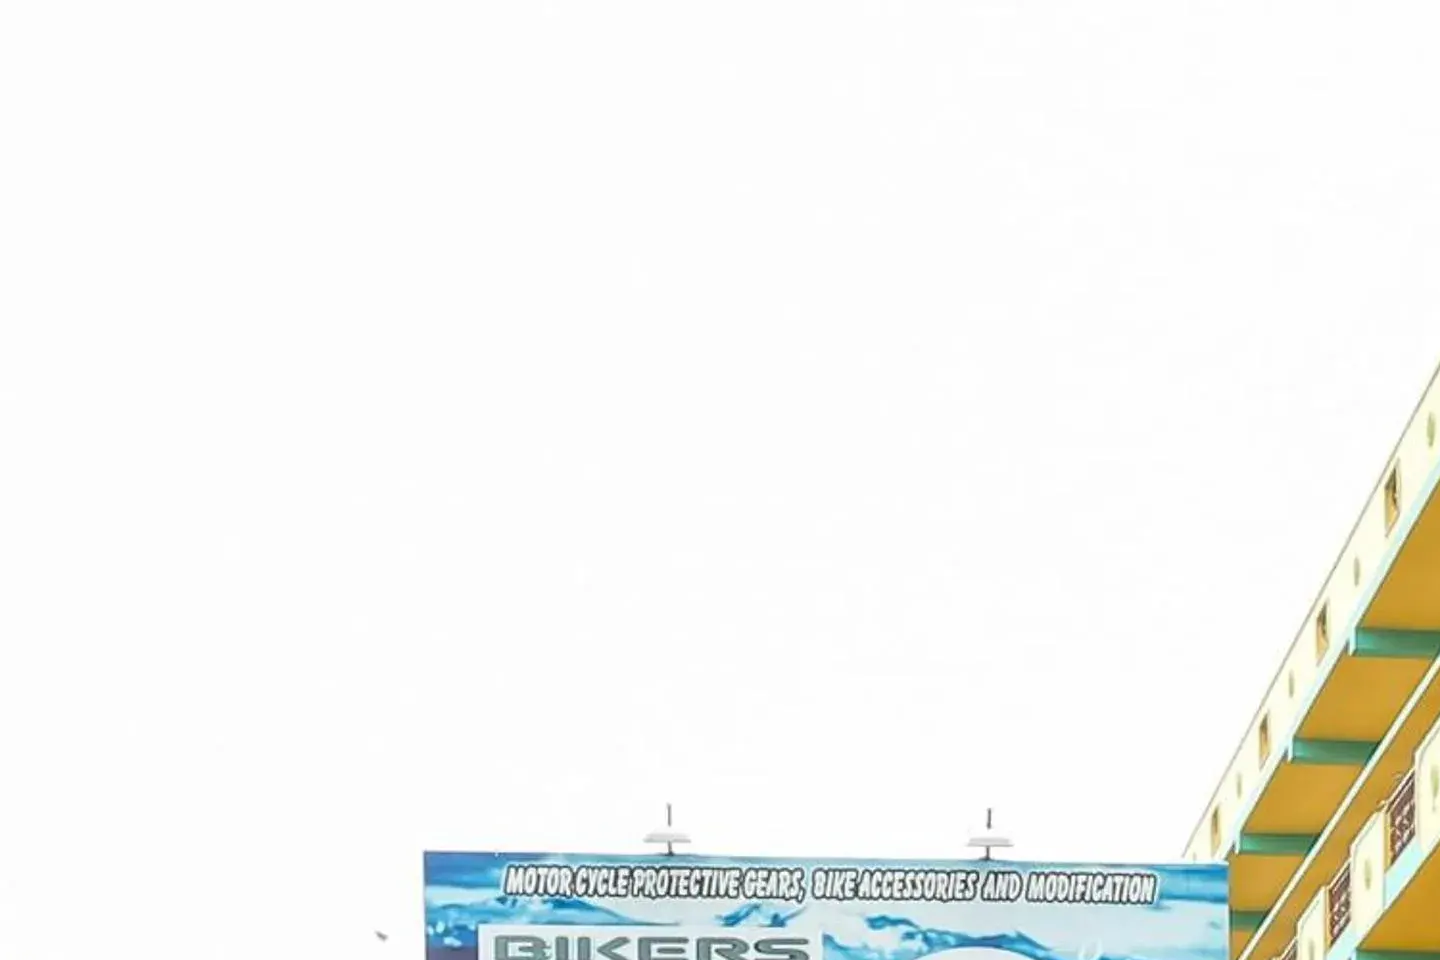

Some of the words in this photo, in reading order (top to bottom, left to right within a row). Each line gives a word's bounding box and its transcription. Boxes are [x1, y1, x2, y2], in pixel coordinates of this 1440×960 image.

[505, 866, 573, 897] MOTOR
[575, 866, 630, 898] CYCLE
[632, 867, 740, 899] PROTECTIVE
[743, 867, 806, 903] GEARS,
[812, 868, 857, 899] BIKE
[857, 869, 979, 902] ACCESSORIES
[981, 872, 1023, 902] AND
[1026, 872, 1156, 904] MODIFICATION
